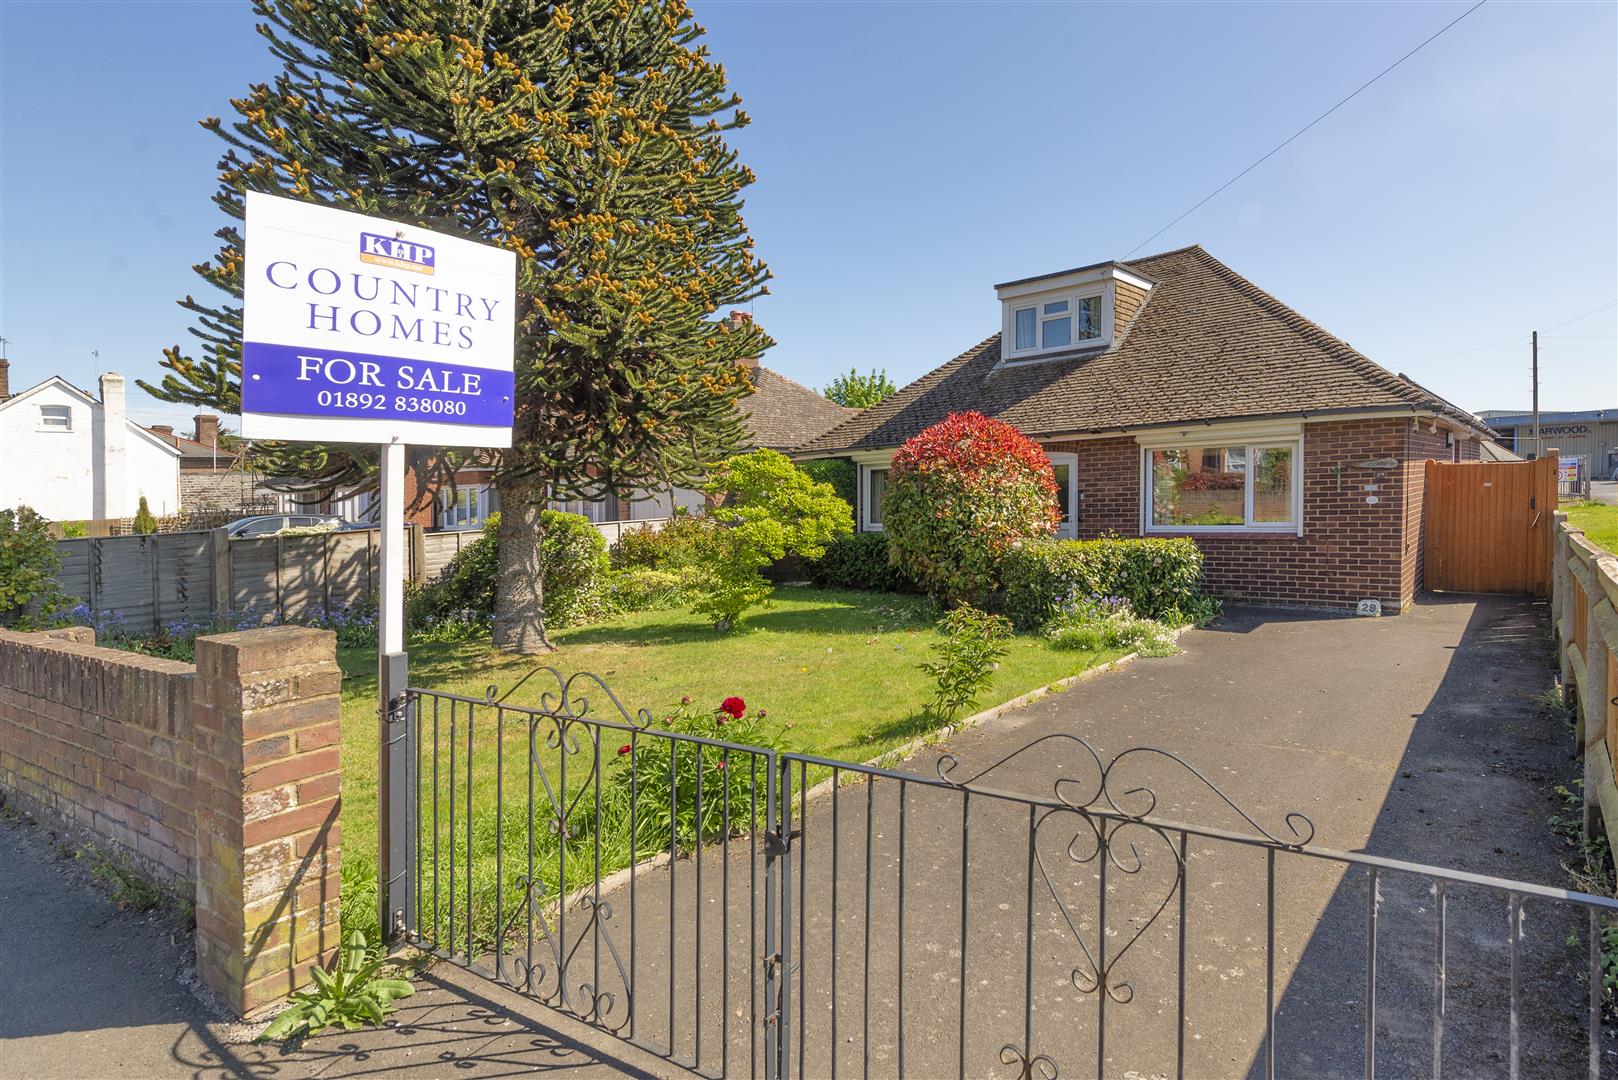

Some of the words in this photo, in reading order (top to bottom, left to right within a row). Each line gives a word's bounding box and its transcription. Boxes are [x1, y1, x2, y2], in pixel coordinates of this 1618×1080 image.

[363, 235, 433, 264] KHP
[266, 261, 501, 321] COUNTRY
[306, 302, 473, 349] HOMES
[296, 355, 386, 387] FOR
[397, 365, 482, 396] SALE
[317, 390, 386, 410] 01892
[394, 396, 467, 416] 838080
[1361, 603, 1376, 612] 29
